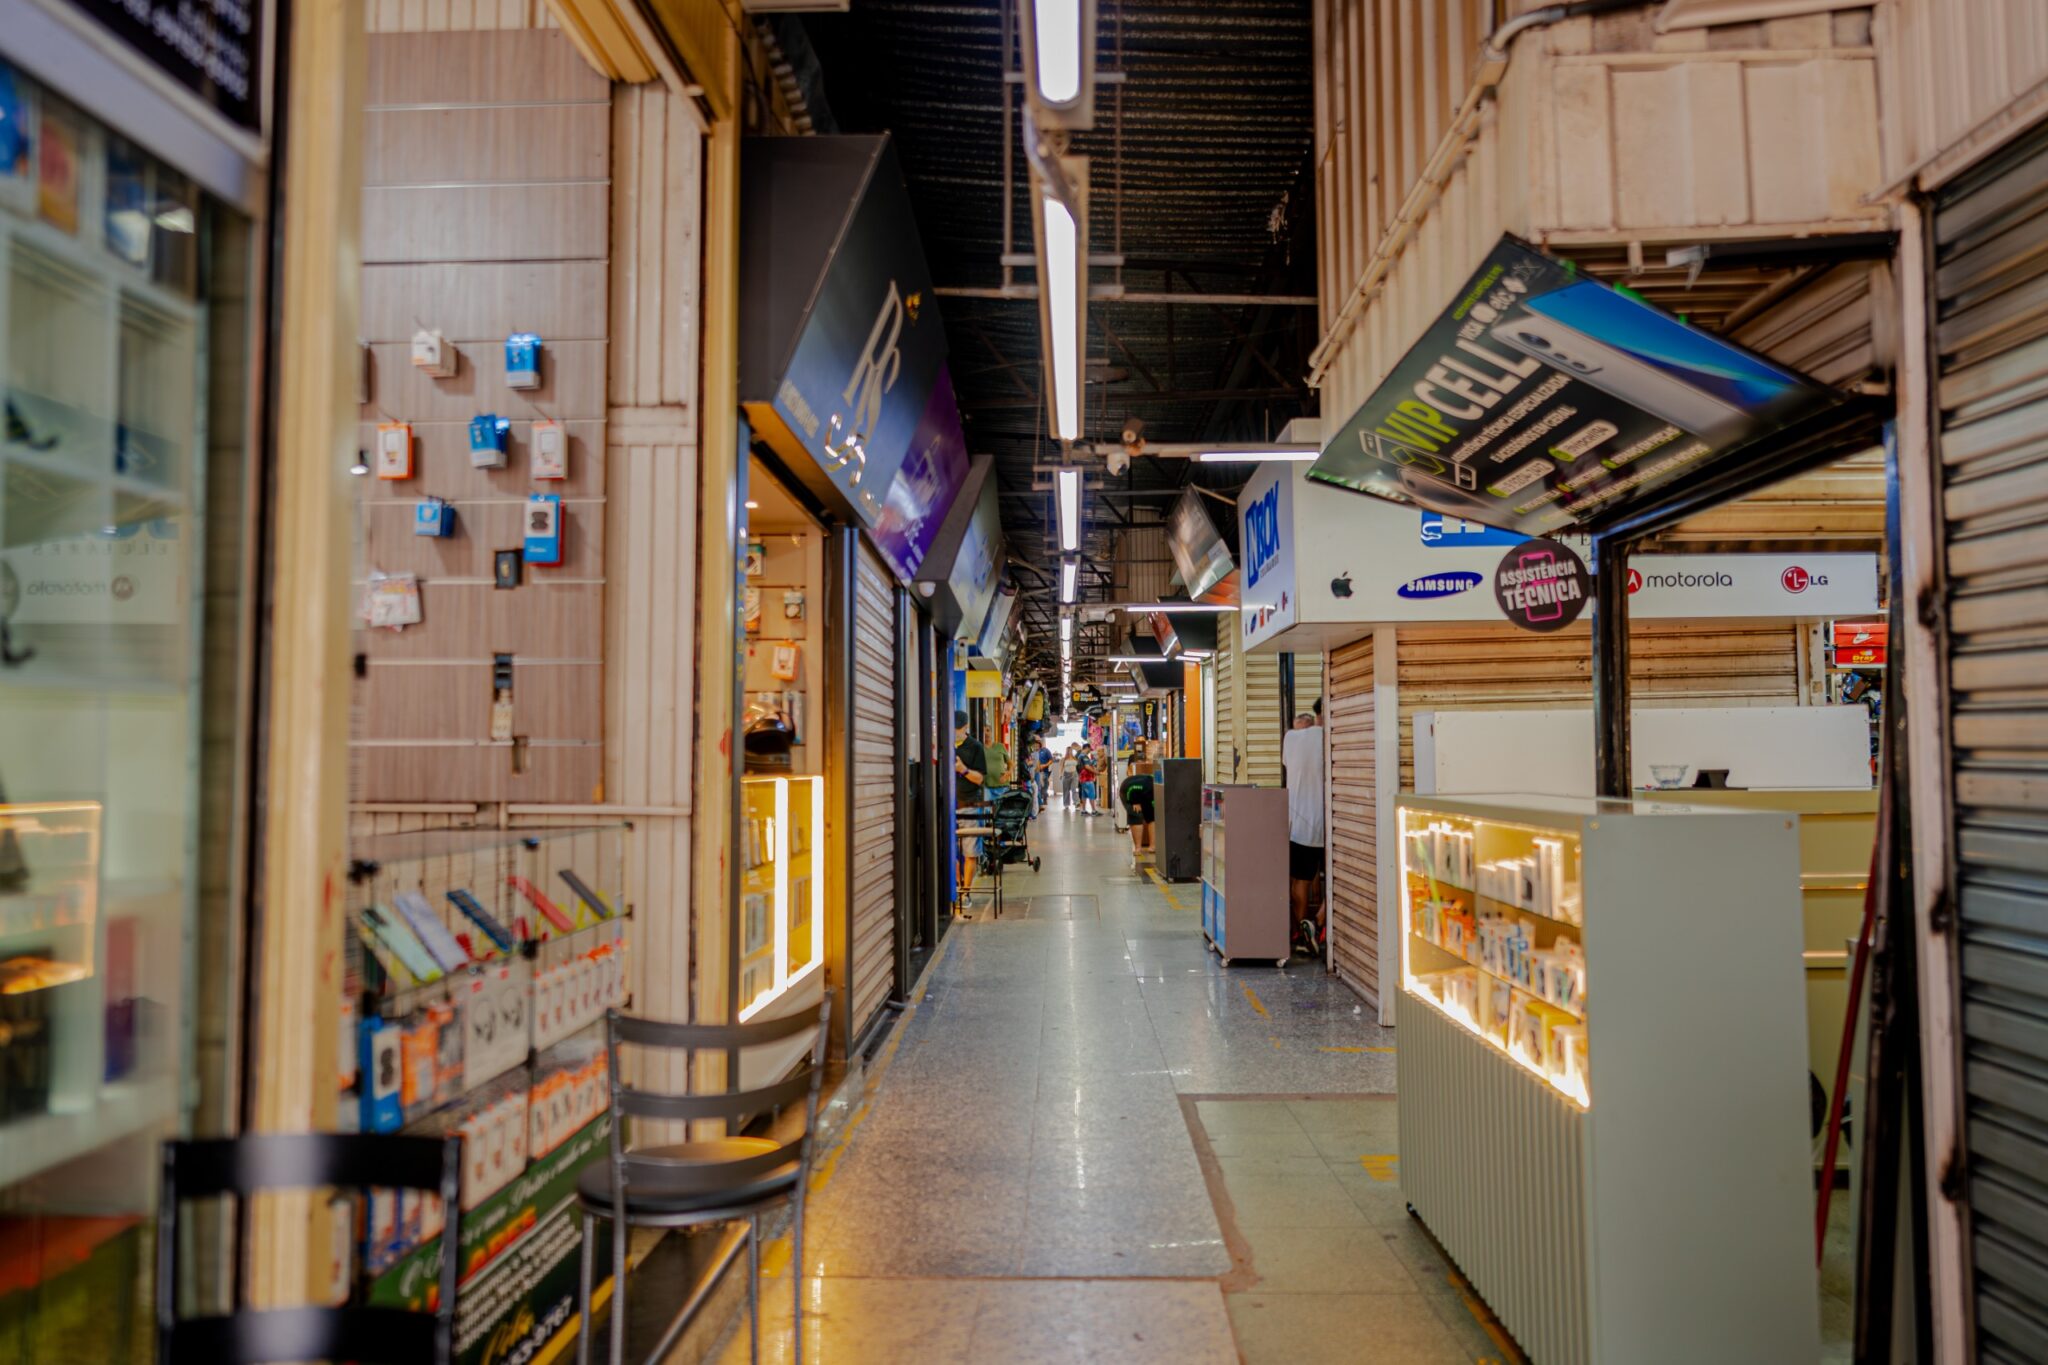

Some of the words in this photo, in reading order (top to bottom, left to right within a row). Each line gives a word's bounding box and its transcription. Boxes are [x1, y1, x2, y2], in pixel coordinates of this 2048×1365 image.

[1407, 579, 1474, 592] SAMSUNG
[1647, 571, 1733, 588] motorola
[1810, 575, 1828, 586] LG
[1503, 577, 1582, 611] TÉCNICA
